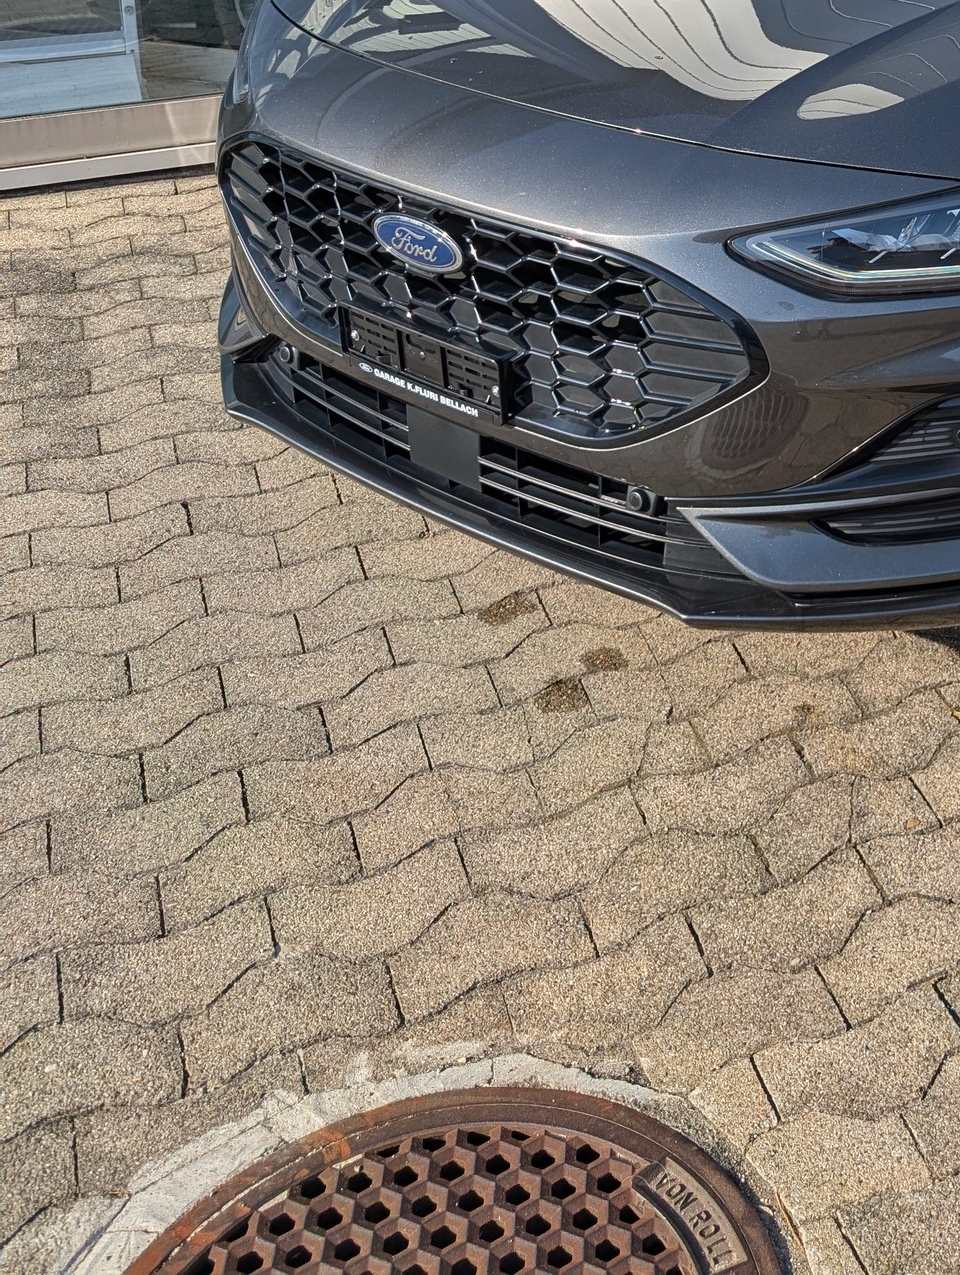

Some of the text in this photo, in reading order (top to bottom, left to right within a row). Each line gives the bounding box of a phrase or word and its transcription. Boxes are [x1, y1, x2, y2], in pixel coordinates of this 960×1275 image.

[391, 227, 438, 262] Ford
[373, 368, 479, 417] GARAGE K.FLURI BELLACH
[655, 1173, 733, 1266] VON ROLL
